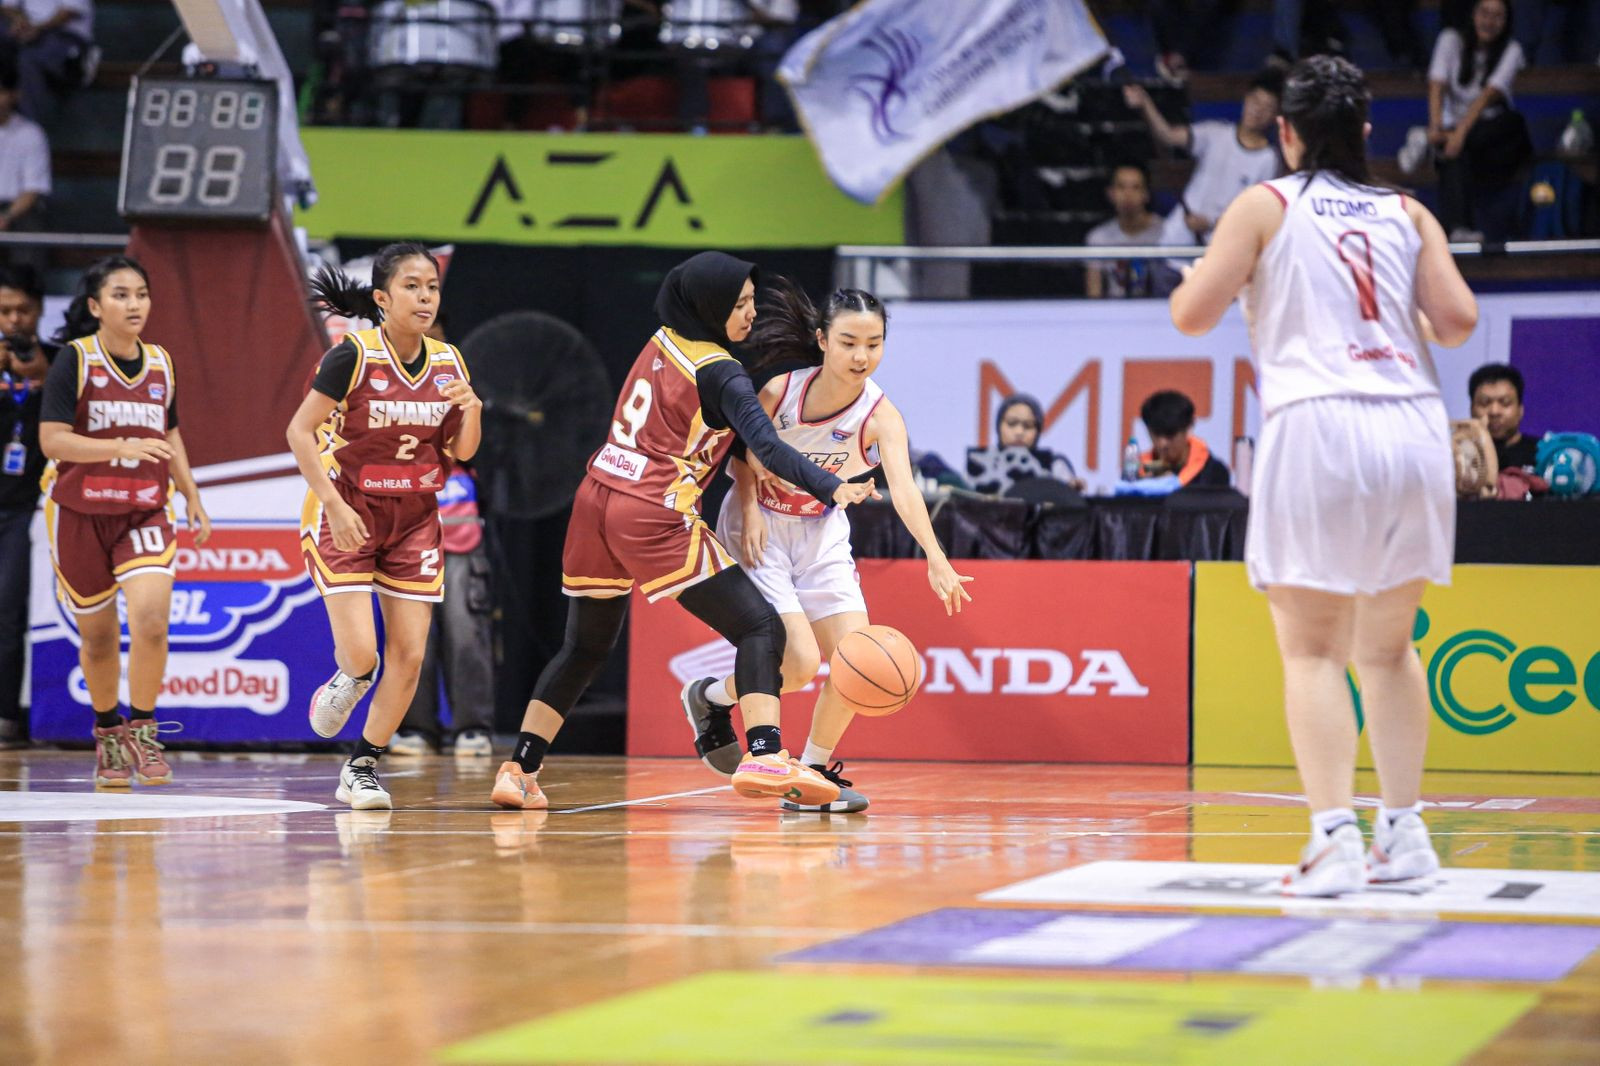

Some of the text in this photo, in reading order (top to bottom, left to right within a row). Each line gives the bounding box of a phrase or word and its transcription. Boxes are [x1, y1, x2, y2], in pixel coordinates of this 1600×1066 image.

[1311, 198, 1378, 217] UTOMO
[612, 378, 653, 449] 9
[395, 434, 419, 460] 2
[616, 454, 638, 477] Day
[364, 479, 382, 489] One
[129, 526, 165, 555] 10
[173, 548, 290, 571] ONDA
[420, 548, 440, 576] 2
[158, 667, 280, 704] ood Day
[800, 647, 1150, 697] NDA
